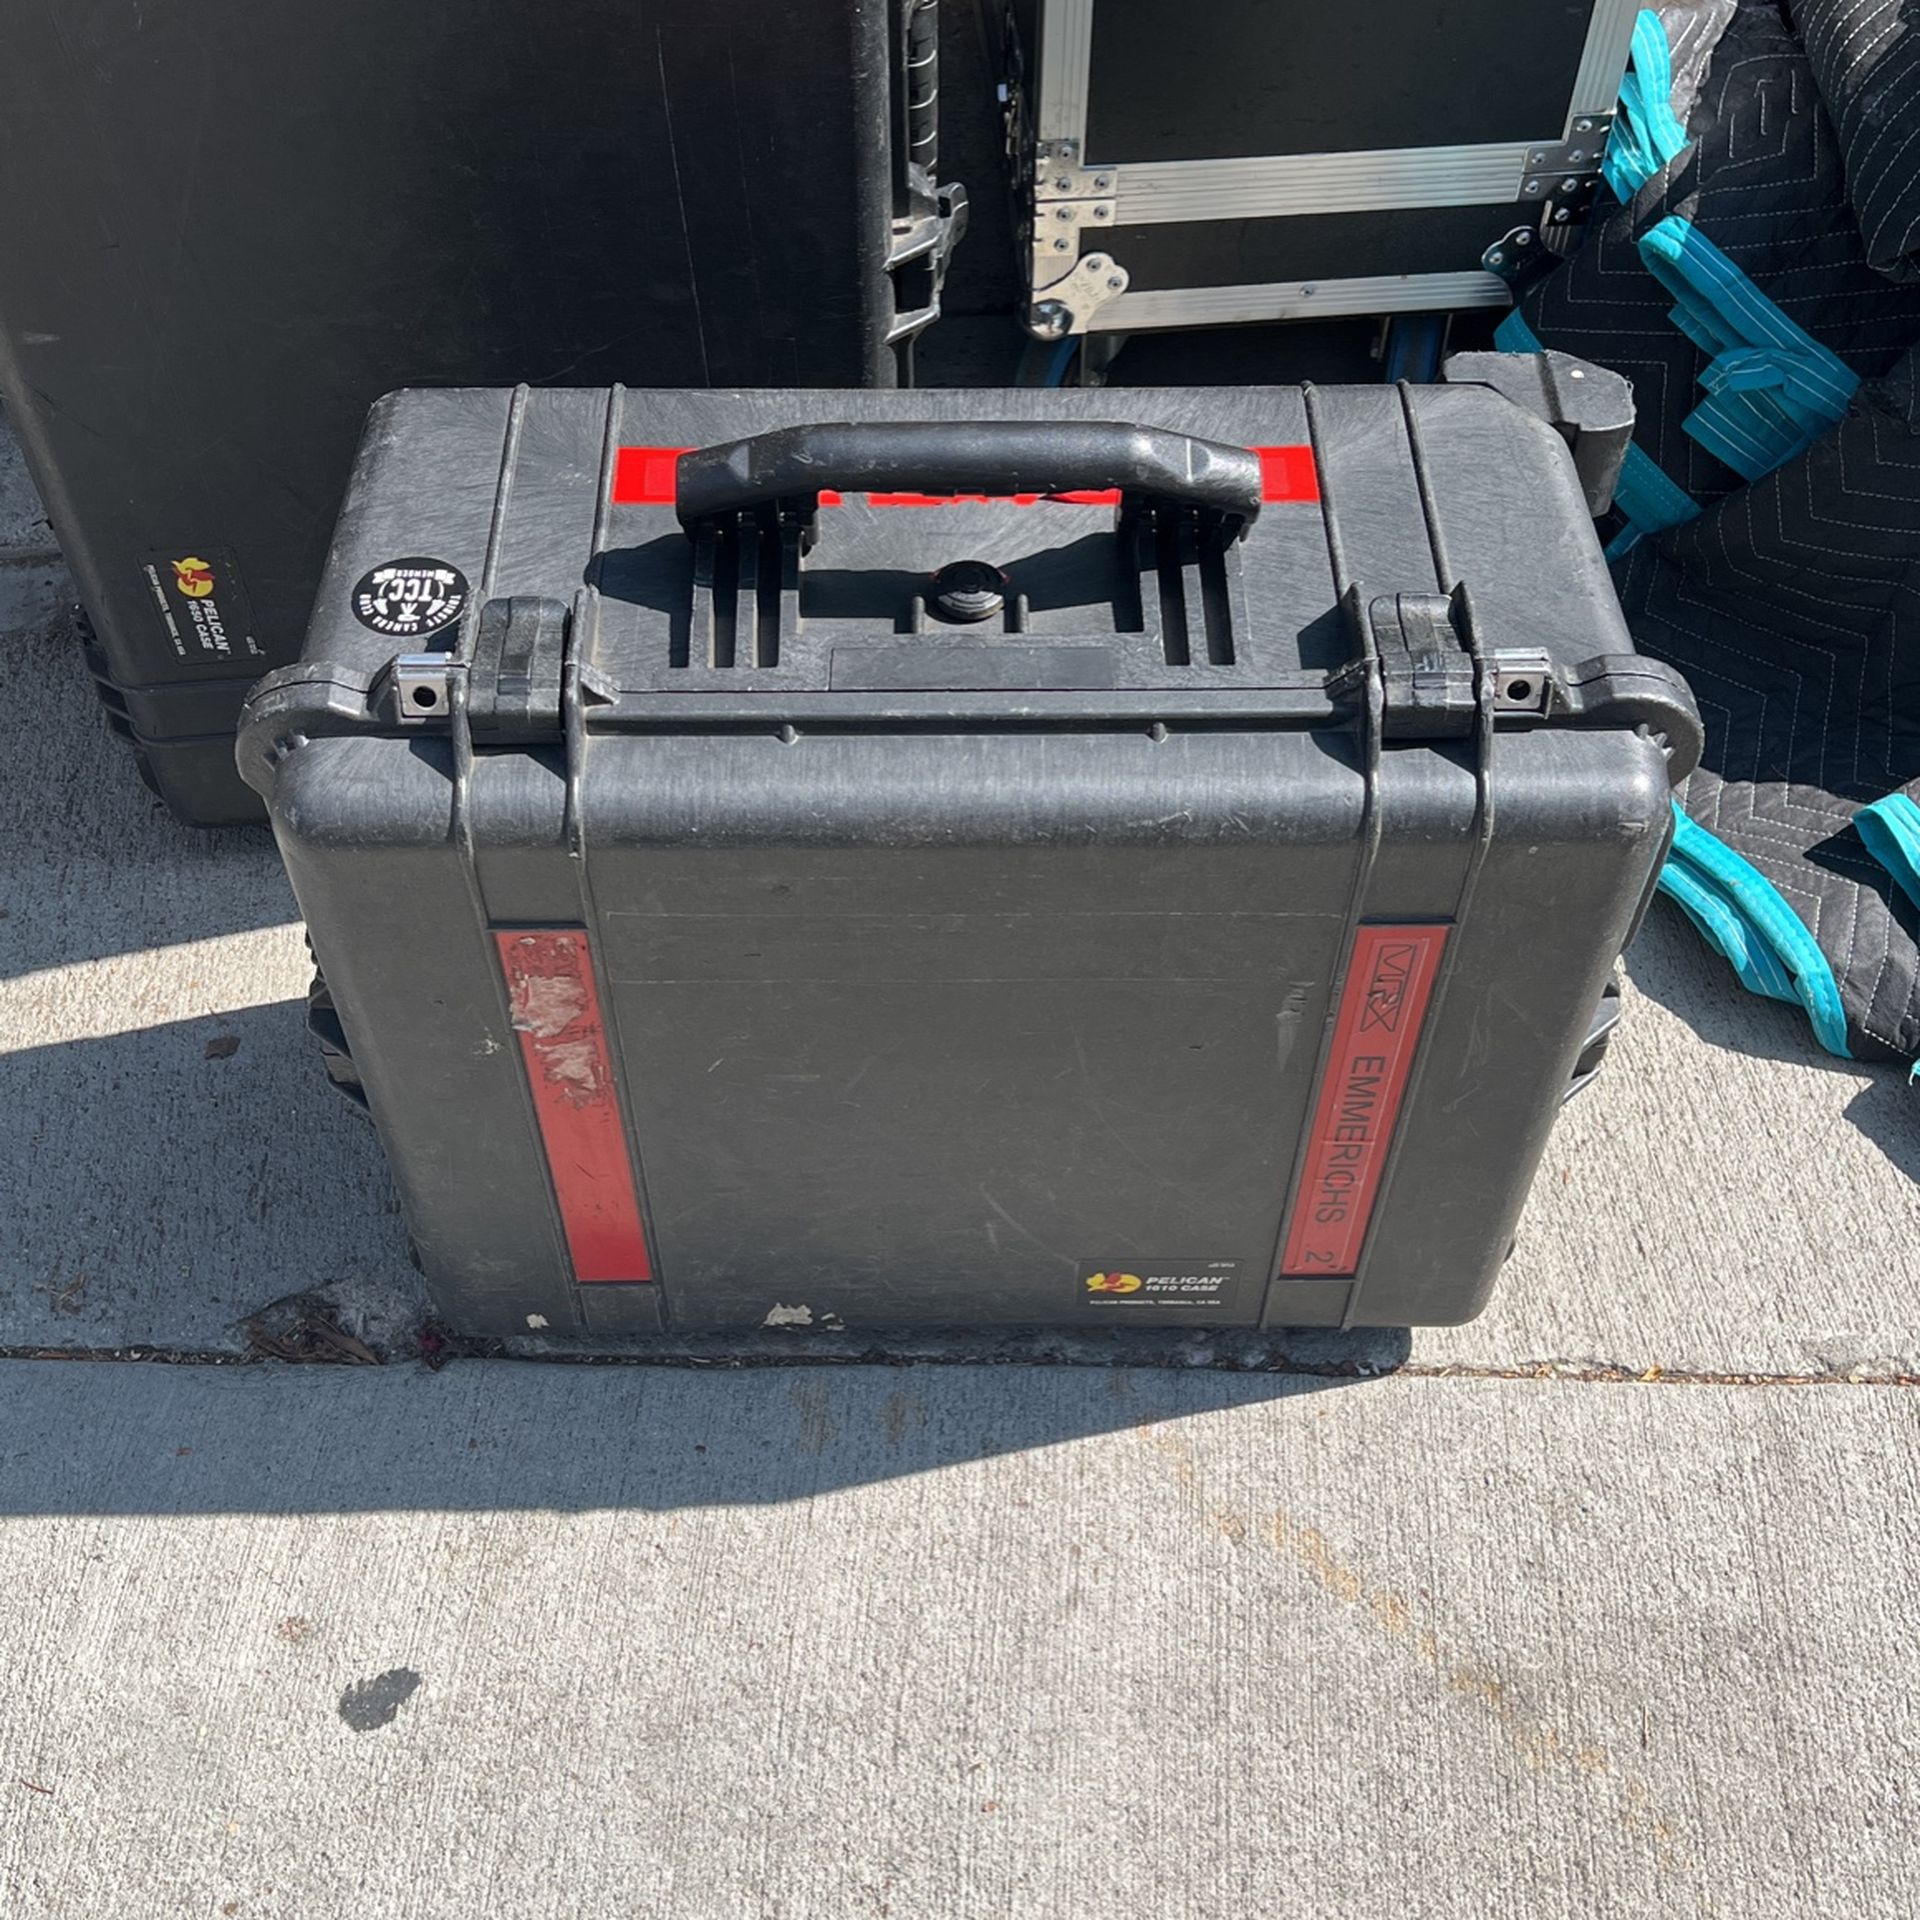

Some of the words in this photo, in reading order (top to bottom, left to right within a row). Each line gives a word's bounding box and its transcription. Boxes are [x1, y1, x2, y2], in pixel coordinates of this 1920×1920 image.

[388, 578, 433, 602] TCC
[187, 600, 204, 622] 1650
[196, 624, 214, 649] CASE
[200, 599, 230, 651] PELICAN
[372, 616, 418, 632] CAMERA
[1315, 1055, 1387, 1223] EMMERICHS
[1145, 1276, 1224, 1285] PELICAN
